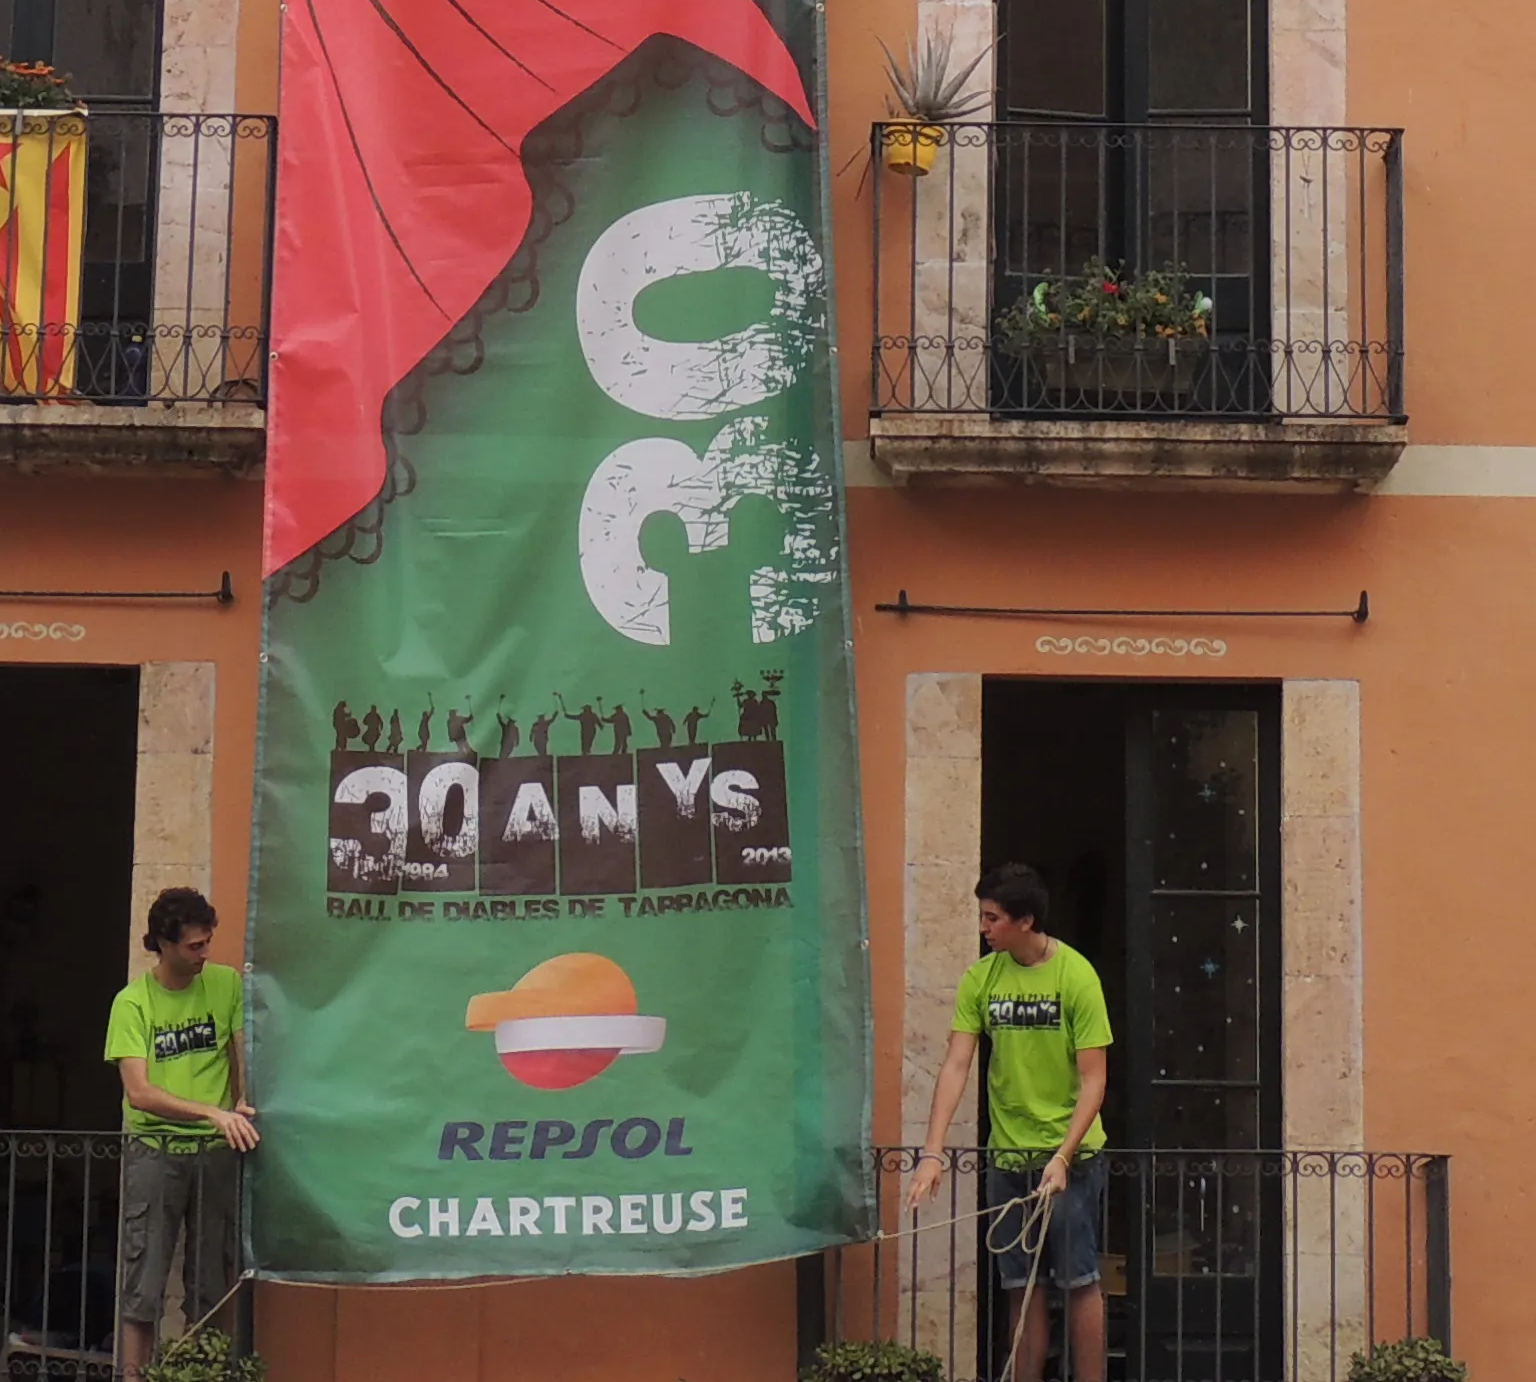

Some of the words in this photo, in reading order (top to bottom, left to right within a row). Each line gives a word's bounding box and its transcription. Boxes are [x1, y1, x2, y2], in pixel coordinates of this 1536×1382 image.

[576, 190, 838, 646] 30
[330, 761, 479, 882] 30
[502, 757, 762, 842] ANYS
[740, 846, 793, 866] 2013
[326, 896, 391, 922] BALL
[398, 900, 436, 921] DE
[443, 899, 560, 922] DIABLES
[568, 897, 605, 919] DE
[437, 1117, 694, 1161] REPSOL
[388, 1188, 749, 1239] CHARTREUSE
